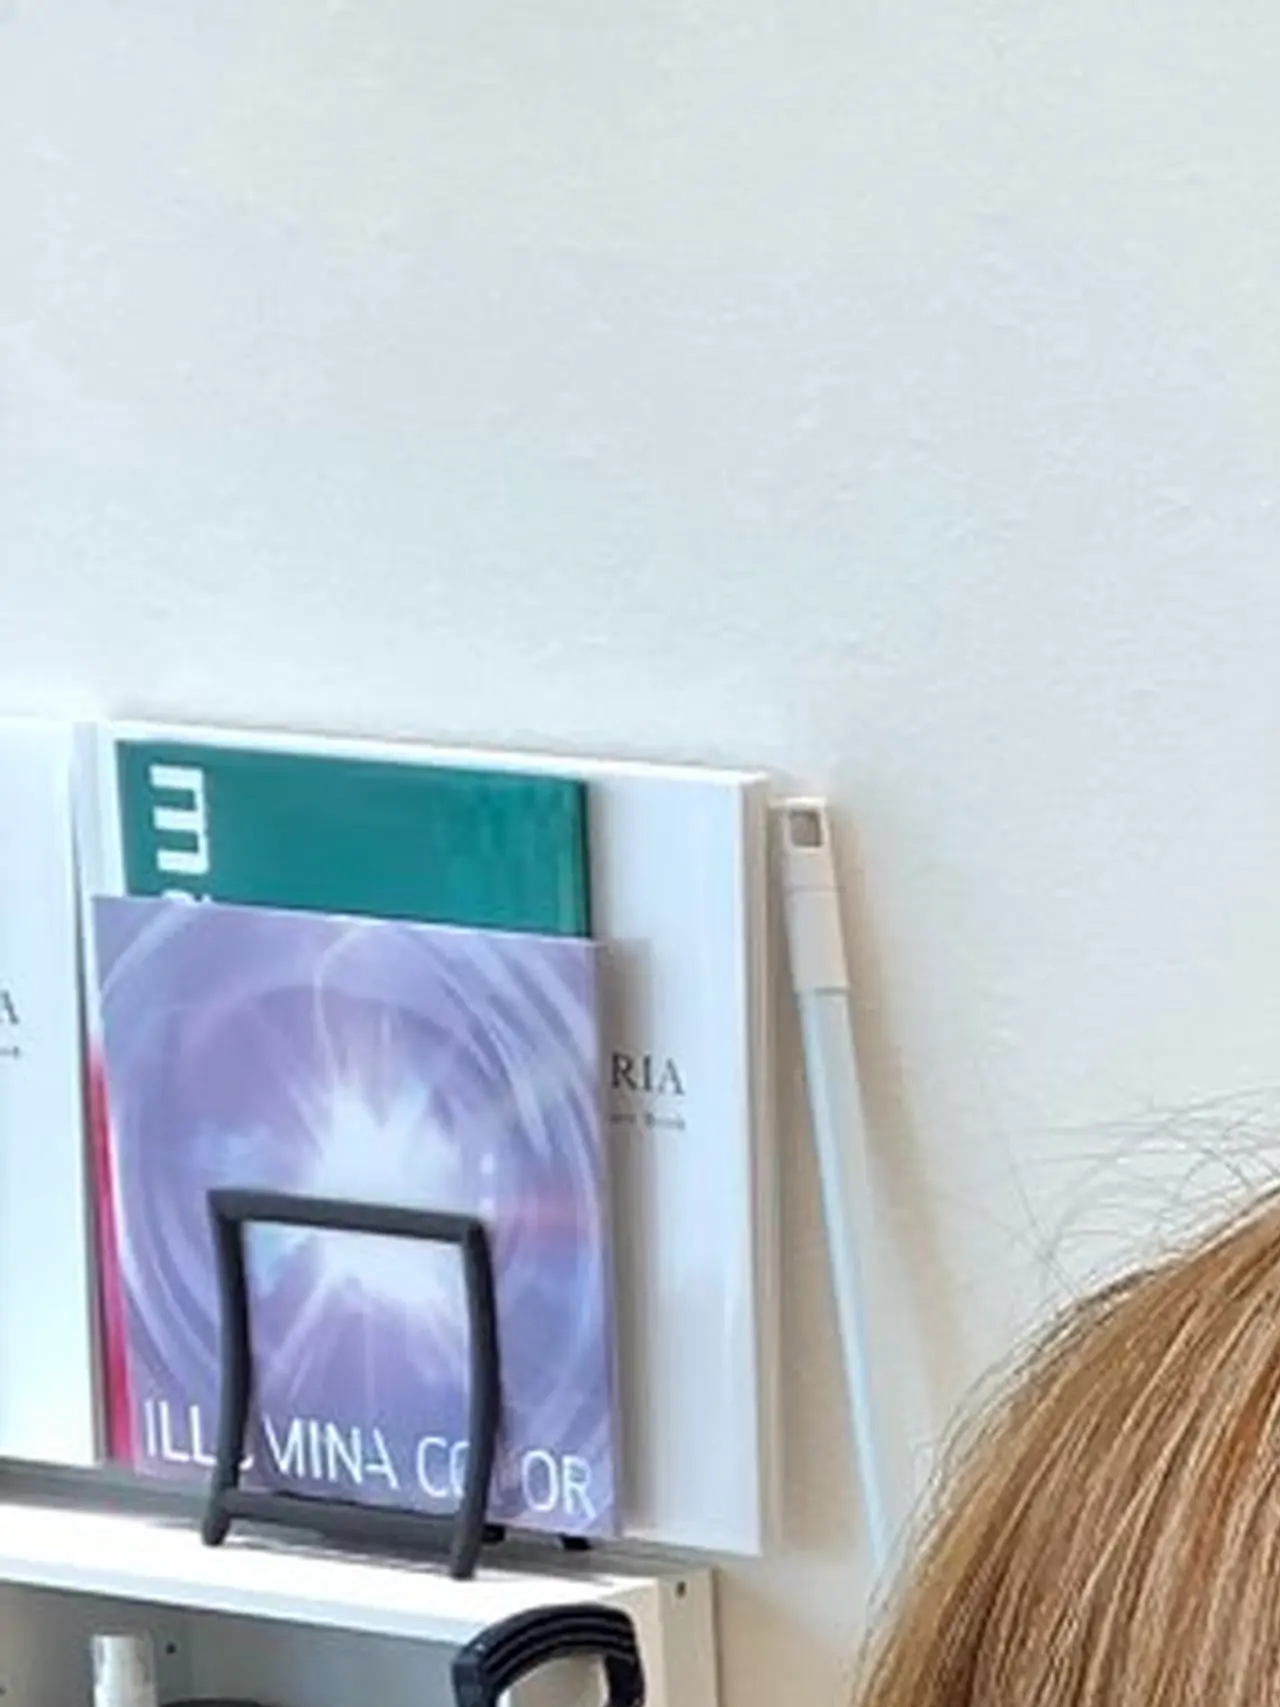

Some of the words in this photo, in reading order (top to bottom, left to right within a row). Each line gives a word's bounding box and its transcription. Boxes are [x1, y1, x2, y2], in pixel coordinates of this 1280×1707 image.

[611, 1052, 685, 1096] RIA
[144, 1400, 400, 1489] ILLMINA
[417, 1436, 598, 1520] COOR
